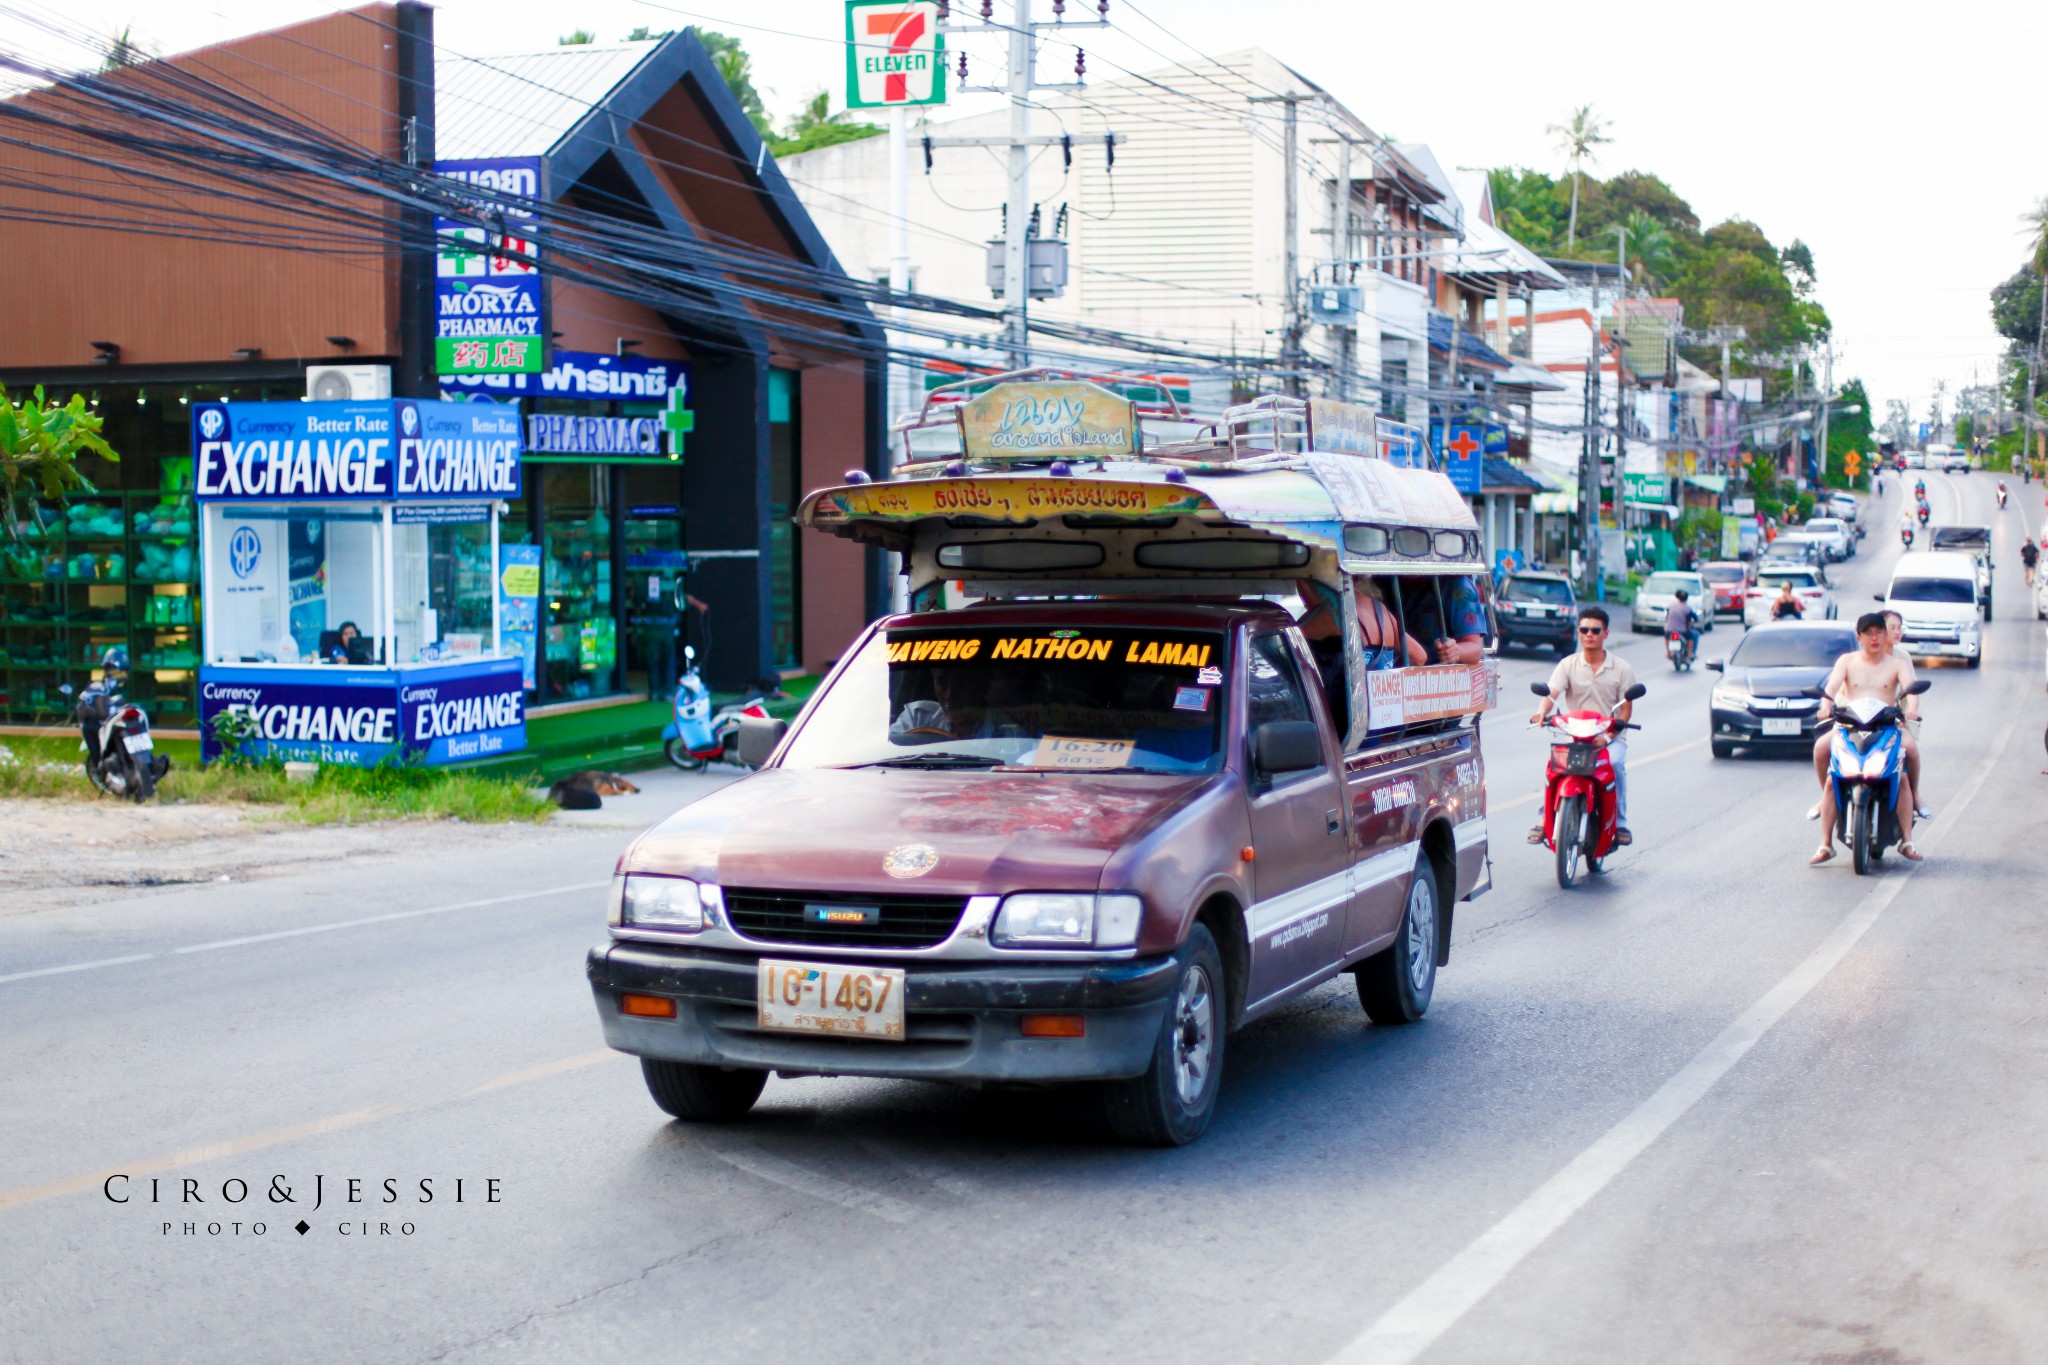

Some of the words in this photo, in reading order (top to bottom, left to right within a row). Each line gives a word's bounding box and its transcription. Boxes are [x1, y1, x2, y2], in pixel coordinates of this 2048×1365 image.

[439, 292, 536, 315] MORYA
[438, 316, 539, 337] PHARMACY
[452, 339, 528, 368] 药店
[541, 357, 667, 396] ฟาร์มาซี
[237, 418, 297, 437] Currency
[306, 416, 352, 433] Better
[354, 415, 389, 432] Rate
[426, 416, 463, 435] Currency
[472, 416, 497, 433] Better
[498, 418, 517, 434] Rate
[528, 414, 661, 454] PHARMACY
[991, 427, 1063, 448] around
[197, 438, 389, 495] EXCHANGE
[397, 438, 518, 493] EXCHANGE
[991, 638, 1112, 661] NATHON
[1125, 641, 1211, 667] LAMAI
[203, 682, 262, 703] Currency
[401, 686, 438, 704] Currency
[415, 691, 522, 740] EXCHANGE
[320, 743, 359, 763] Rate
[448, 737, 478, 757] Better
[480, 733, 502, 752] Rate
[1051, 739, 1125, 753] 16:20
[768, 966, 893, 1014] 10-1467
